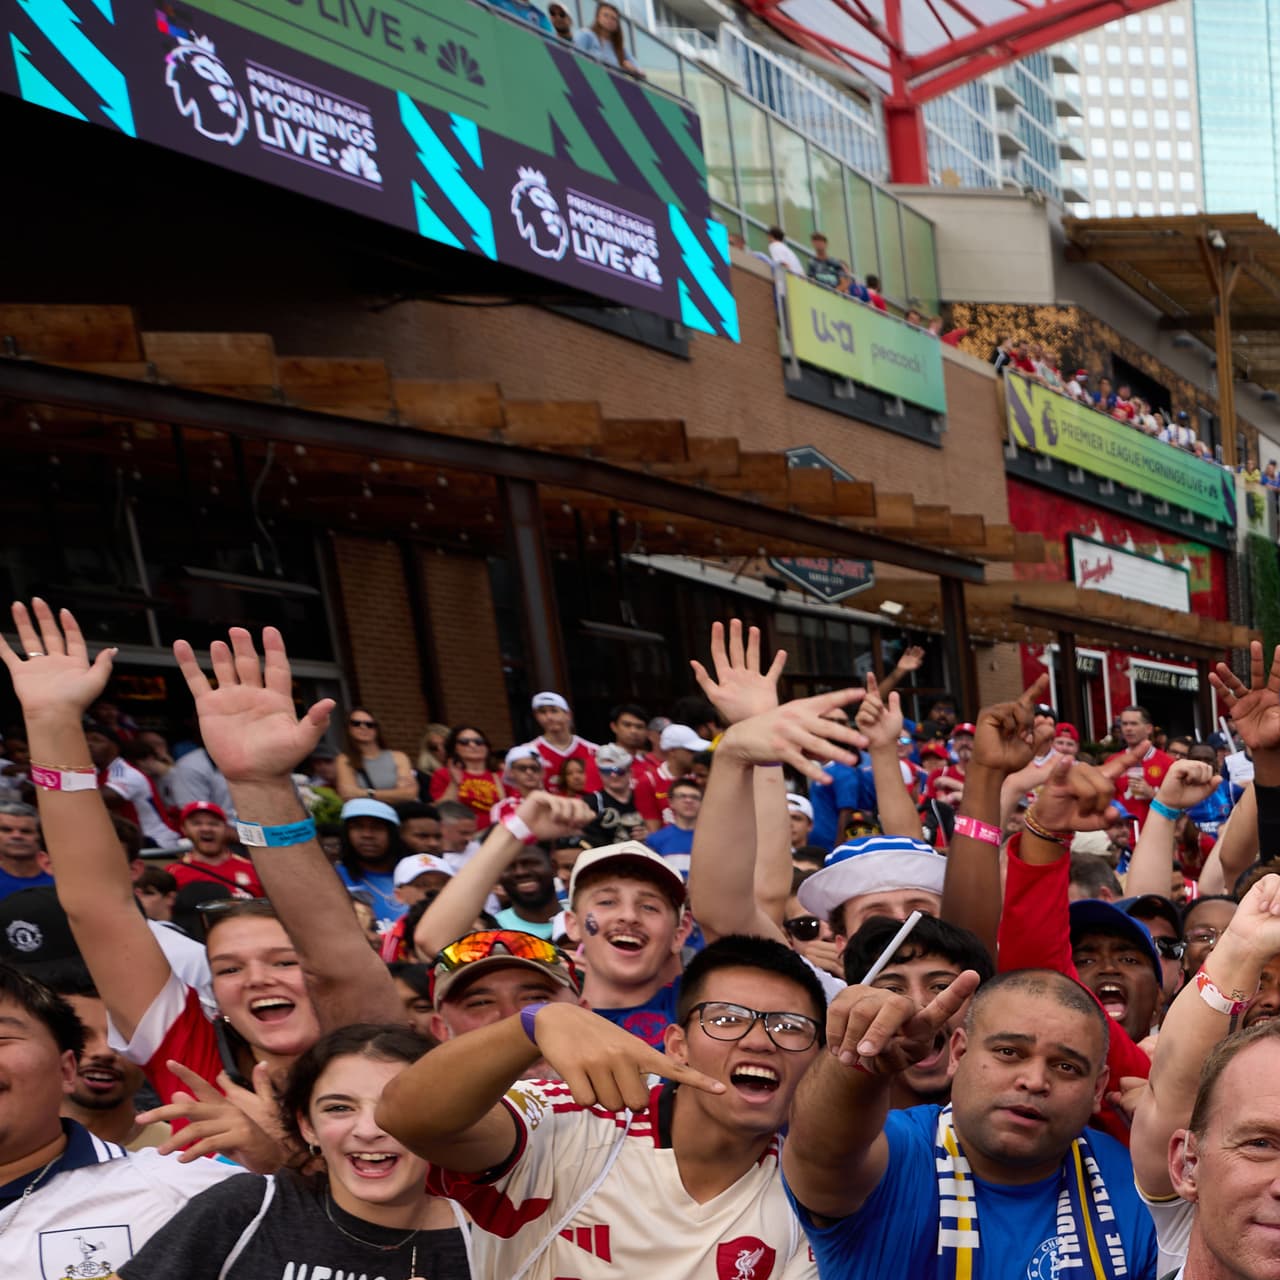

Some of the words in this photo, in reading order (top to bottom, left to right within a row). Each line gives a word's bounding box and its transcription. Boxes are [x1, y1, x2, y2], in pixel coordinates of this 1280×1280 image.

[317, 0, 405, 53] LIVE
[246, 67, 314, 104] PREMIER
[315, 94, 373, 130] LEAGUE
[249, 85, 377, 151] MORNINGS
[254, 110, 331, 165] LIVE
[568, 208, 660, 260] MORNINGS
[571, 229, 627, 273] LIVE
[1061, 421, 1103, 449] PREMIER
[1106, 441, 1141, 467] LEAGUE
[1141, 454, 1186, 487] MORNINGS
